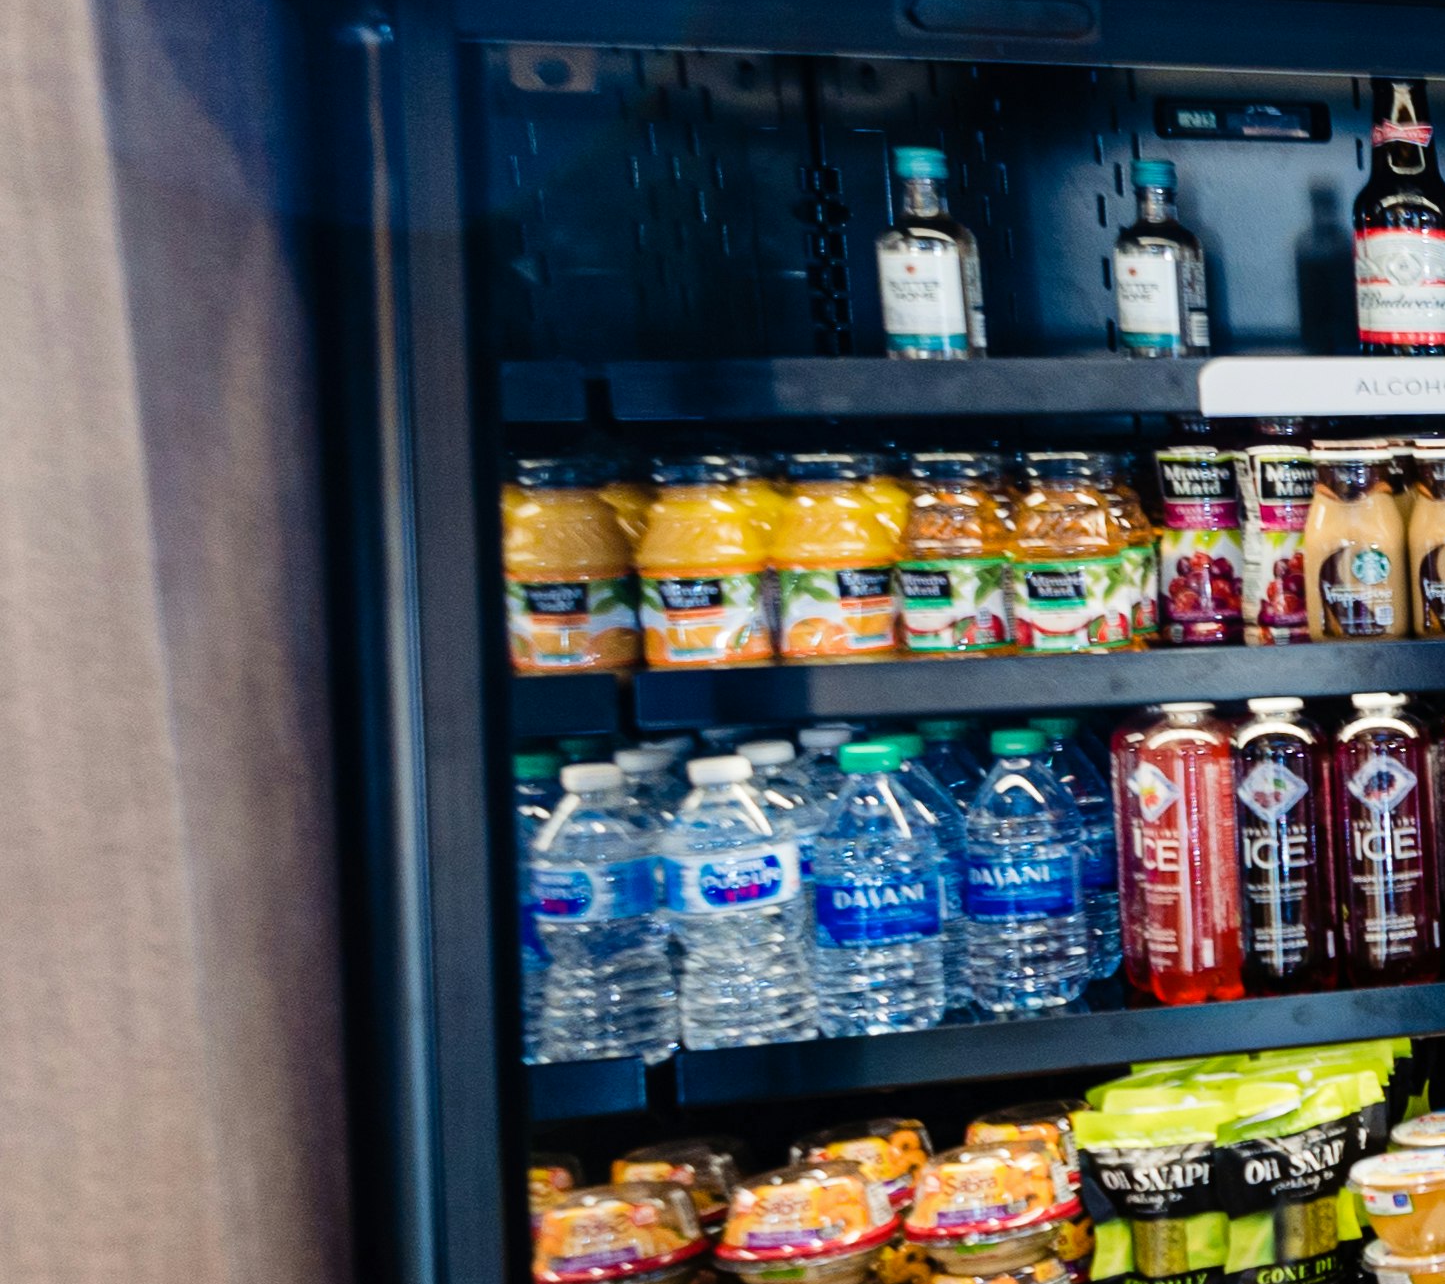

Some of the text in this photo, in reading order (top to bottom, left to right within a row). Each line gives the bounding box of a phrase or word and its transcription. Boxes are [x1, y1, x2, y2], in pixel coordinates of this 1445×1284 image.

[1164, 463, 1230, 483] Minute
[1174, 480, 1222, 497] Maid
[1243, 834, 1308, 870] ICE
[1352, 826, 1418, 862] ICE
[967, 864, 1051, 892] DASANI
[831, 882, 925, 911] DASANI
[1101, 1162, 1210, 1193] OH SNAP!
[1244, 1158, 1281, 1186] OH
